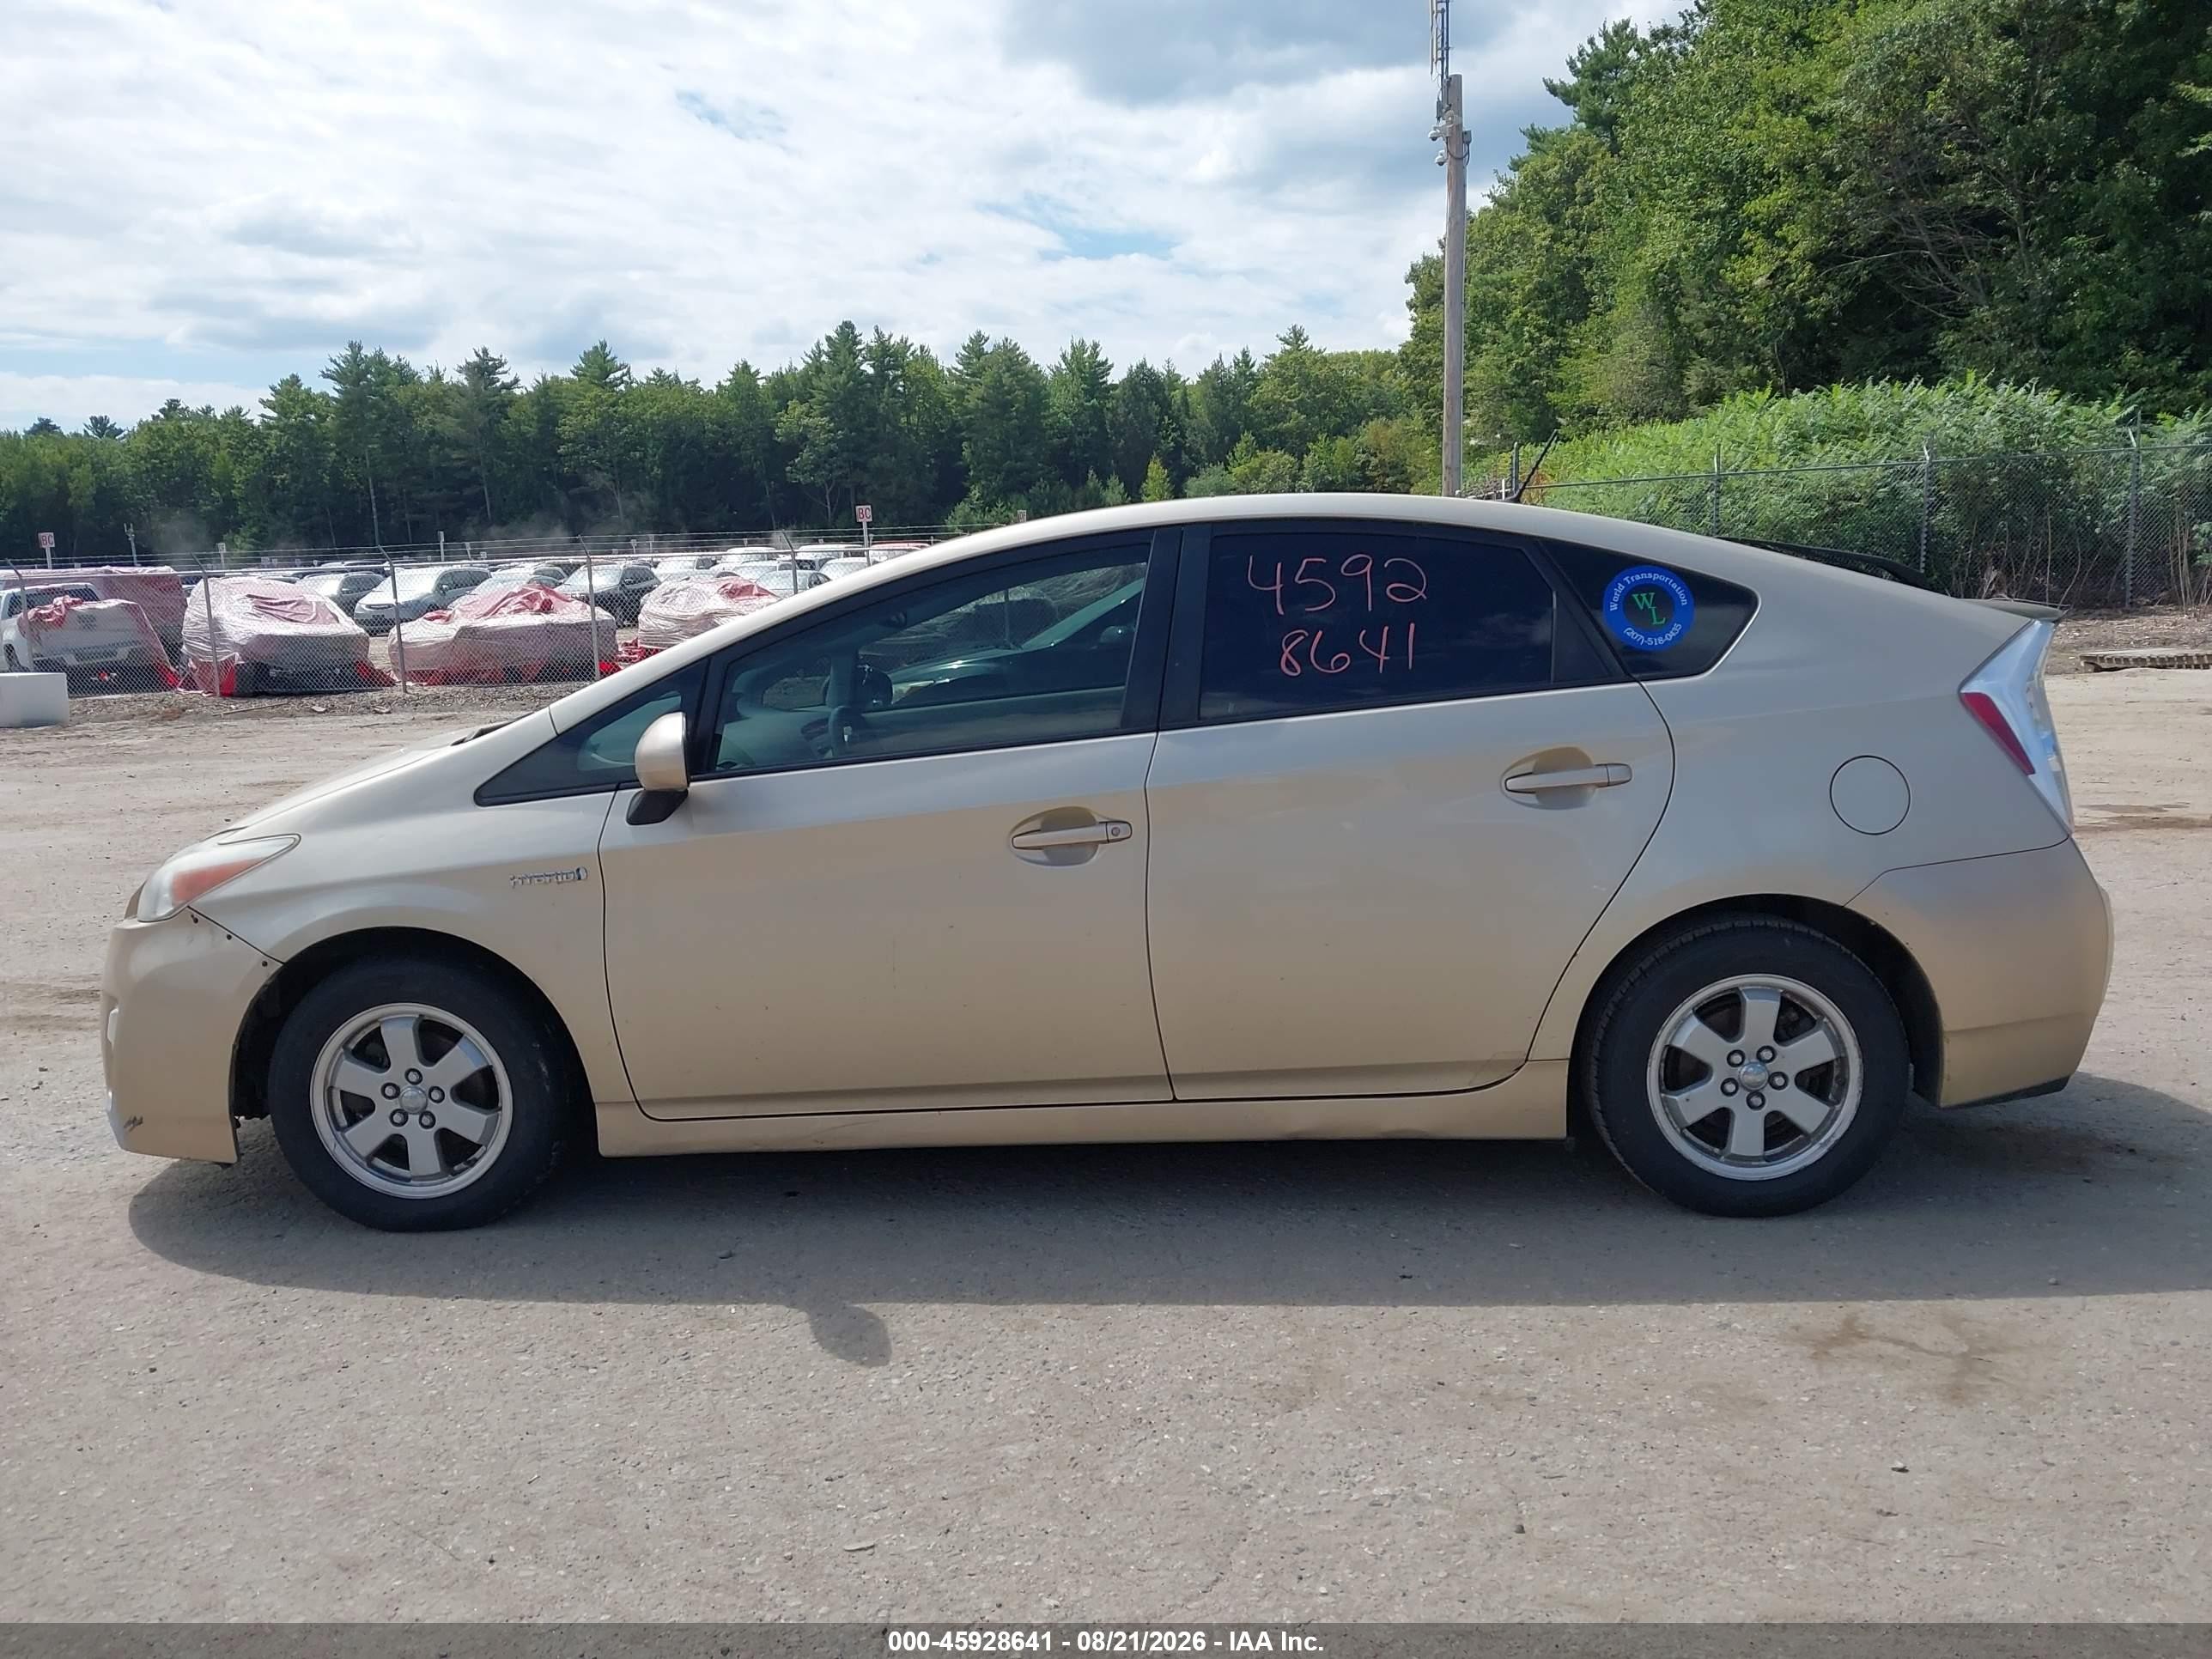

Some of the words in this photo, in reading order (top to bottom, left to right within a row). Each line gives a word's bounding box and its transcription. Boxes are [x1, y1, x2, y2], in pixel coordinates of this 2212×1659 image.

[859, 507, 872, 520] BC
[1247, 553, 1428, 616] 4592
[1610, 582, 1626, 611] World
[1623, 572, 1688, 606] Transportation
[1279, 622, 1416, 678] 8641
